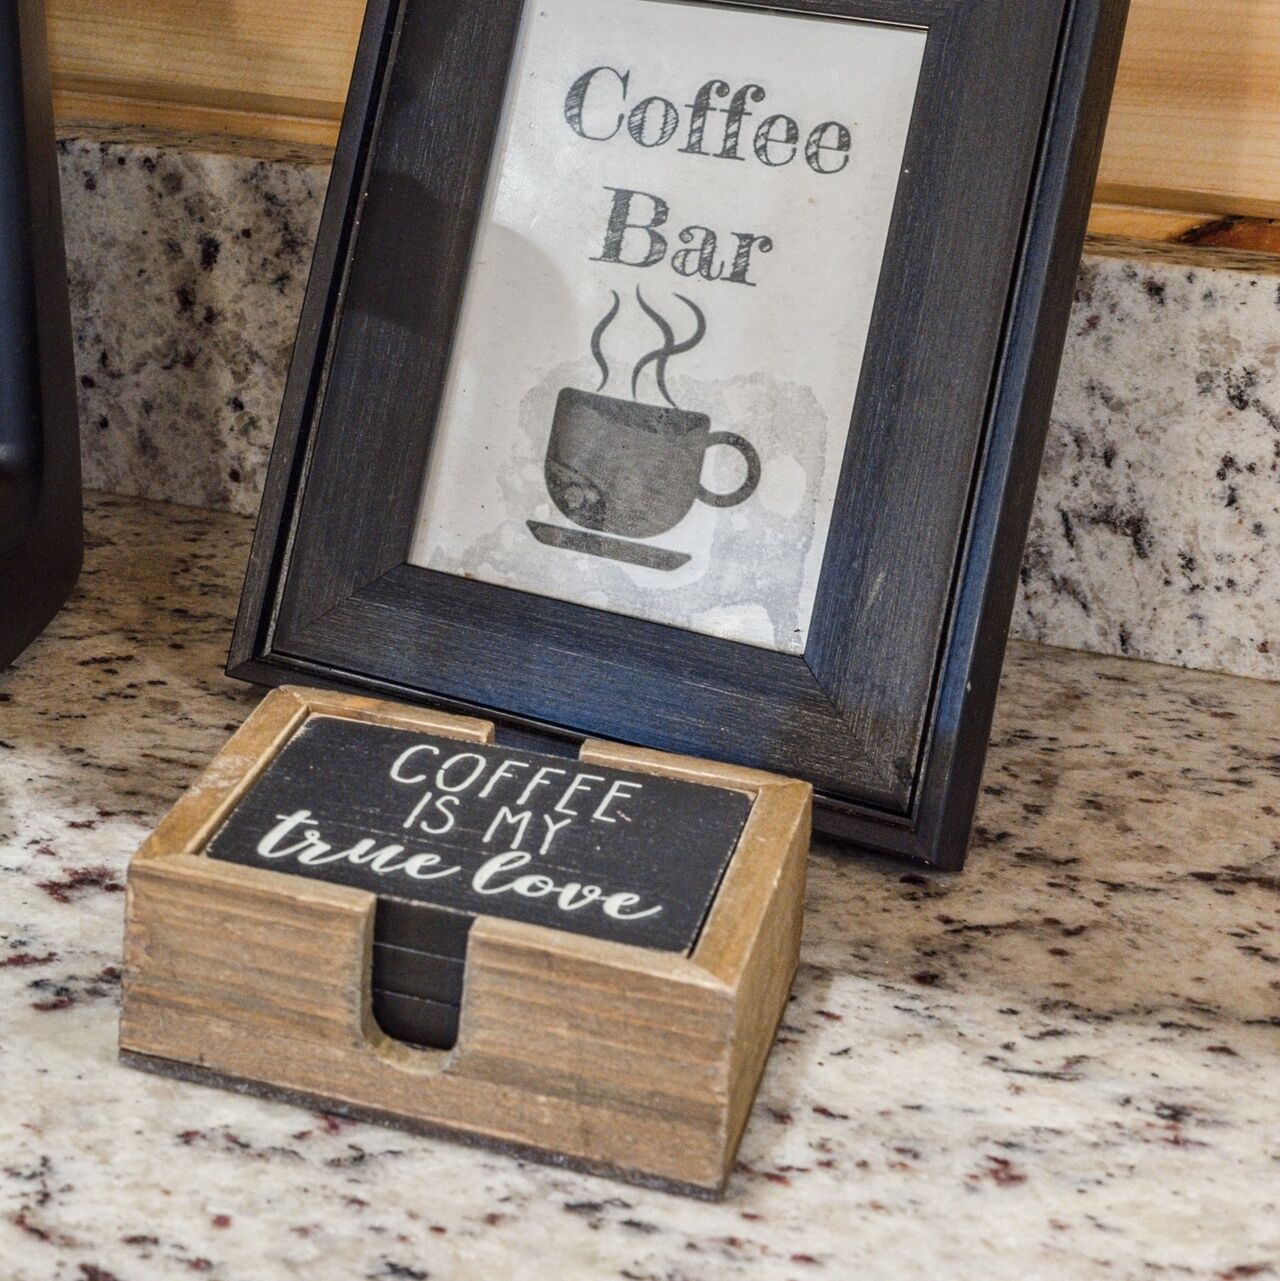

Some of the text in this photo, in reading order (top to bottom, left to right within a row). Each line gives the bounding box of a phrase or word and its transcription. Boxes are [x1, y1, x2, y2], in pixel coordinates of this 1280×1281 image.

[563, 64, 852, 176] Coffee
[589, 185, 773, 288] Bar
[389, 744, 643, 824] COFFEE
[403, 792, 571, 856] IS MY
[256, 809, 663, 920] true love
